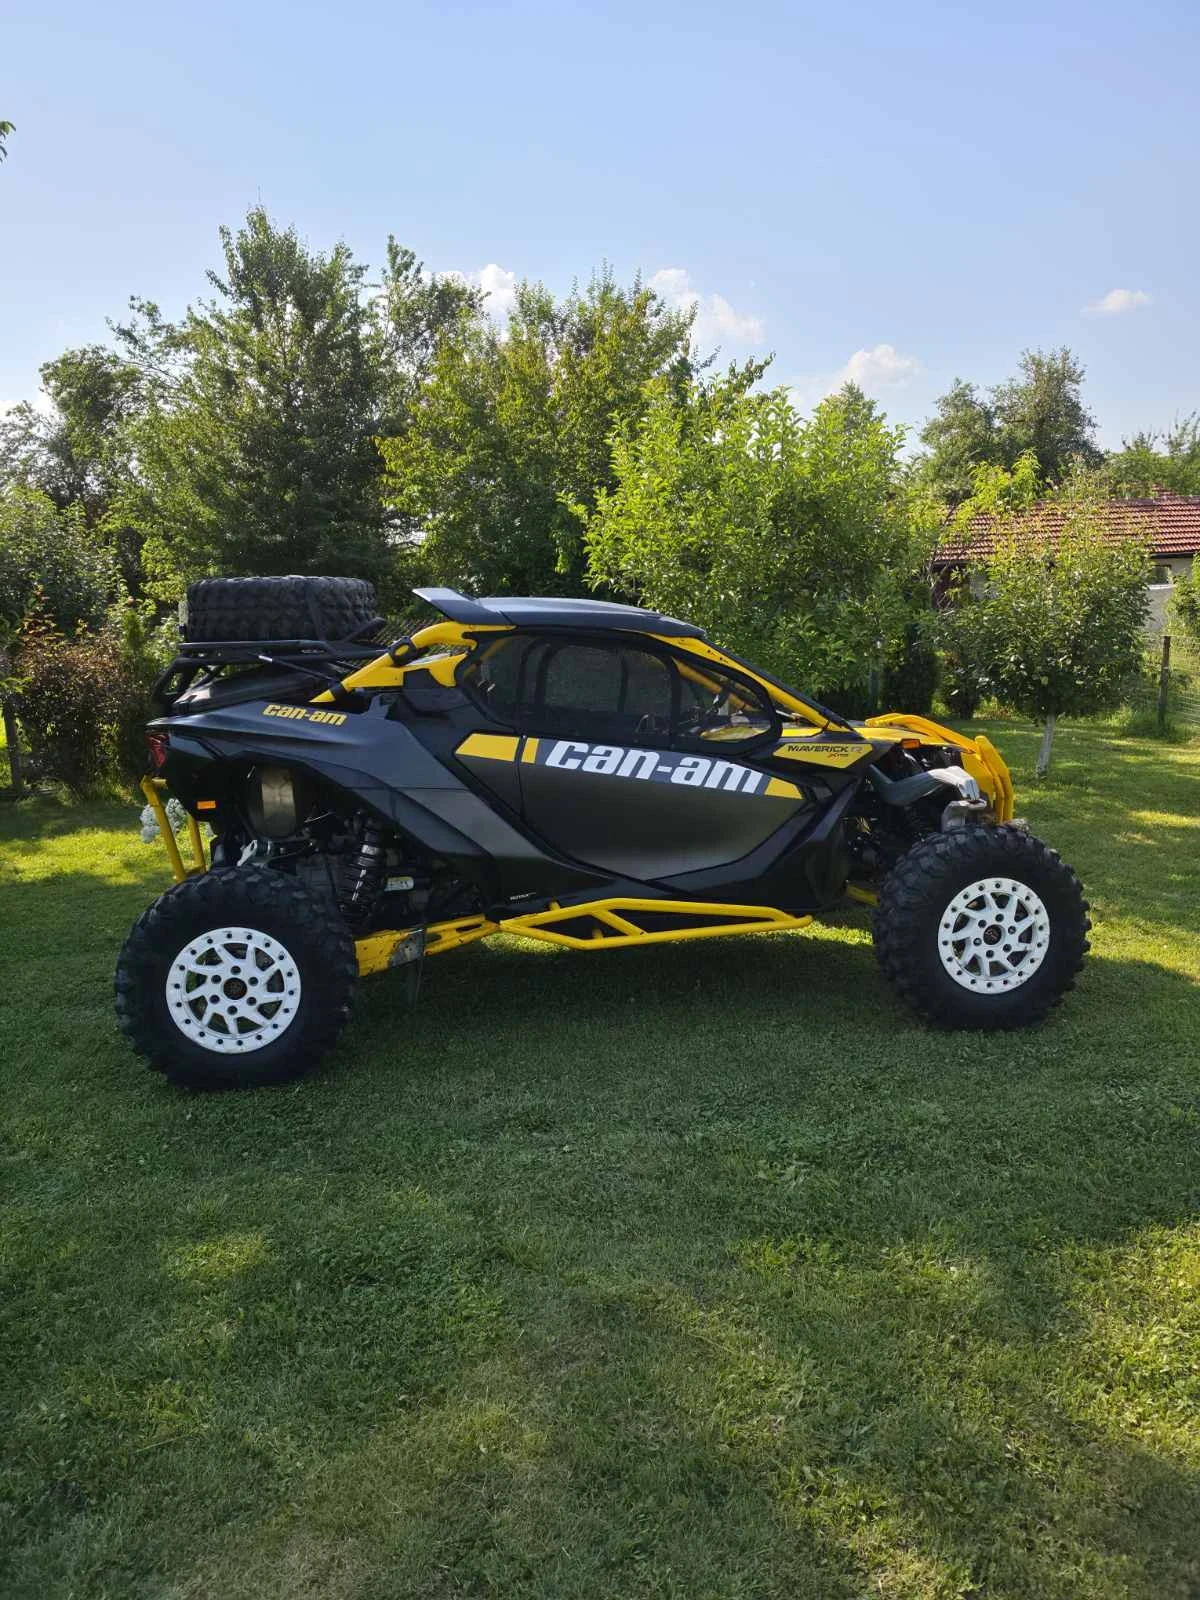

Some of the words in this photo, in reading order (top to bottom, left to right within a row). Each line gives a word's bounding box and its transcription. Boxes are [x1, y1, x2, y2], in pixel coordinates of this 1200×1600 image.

[263, 704, 347, 726] can-am
[787, 744, 849, 753] MAVERICK
[545, 740, 763, 794] can-am
